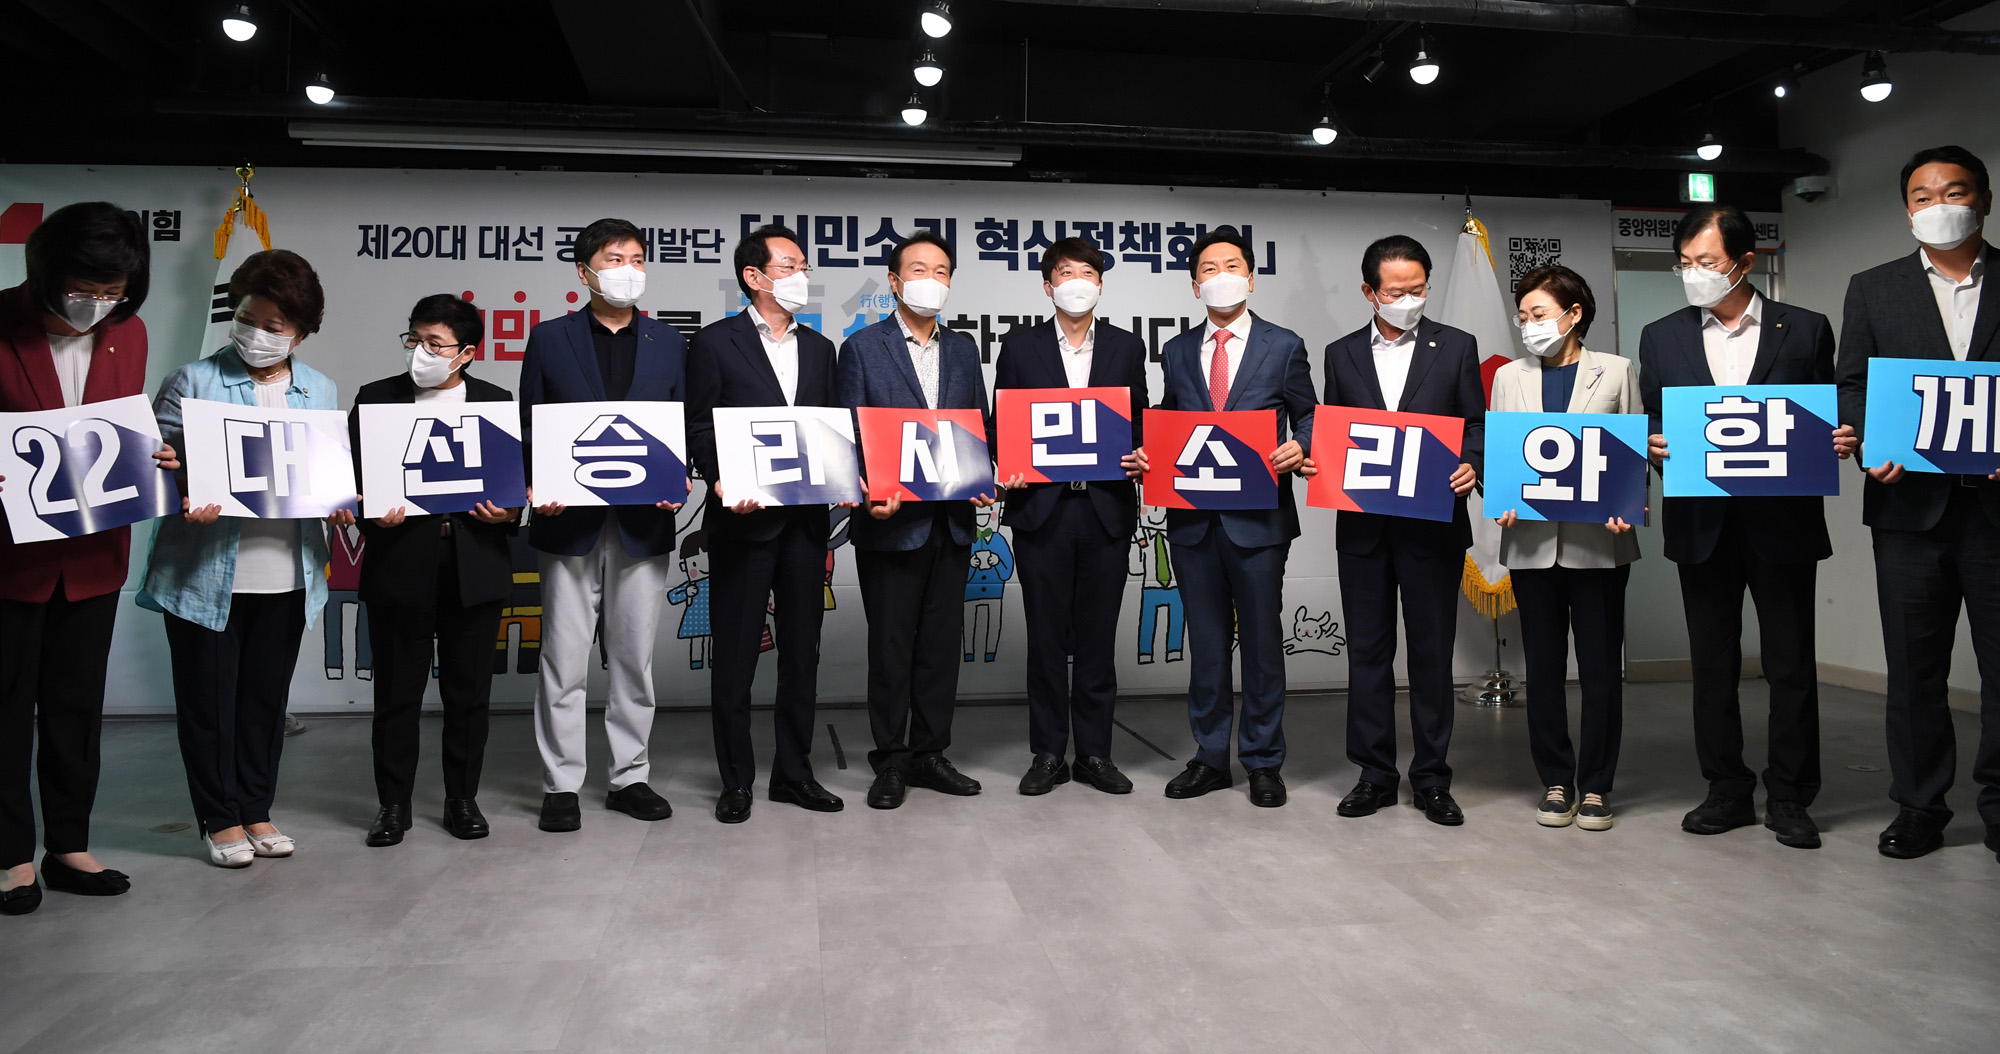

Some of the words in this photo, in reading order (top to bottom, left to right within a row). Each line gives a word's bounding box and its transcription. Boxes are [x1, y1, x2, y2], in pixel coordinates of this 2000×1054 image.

[357, 224, 467, 260] 제20대
[478, 225, 544, 262] 대선
[12, 417, 140, 516] 22
[223, 418, 311, 497] 대
[402, 415, 484, 497] 선
[572, 414, 648, 489] 승
[751, 417, 826, 488] 리
[900, 419, 961, 483] 시
[1031, 398, 1098, 467] 민
[1173, 424, 1242, 492] 소
[1343, 421, 1423, 498] 리
[1522, 424, 1608, 502] 와
[1704, 395, 1795, 478] 함
